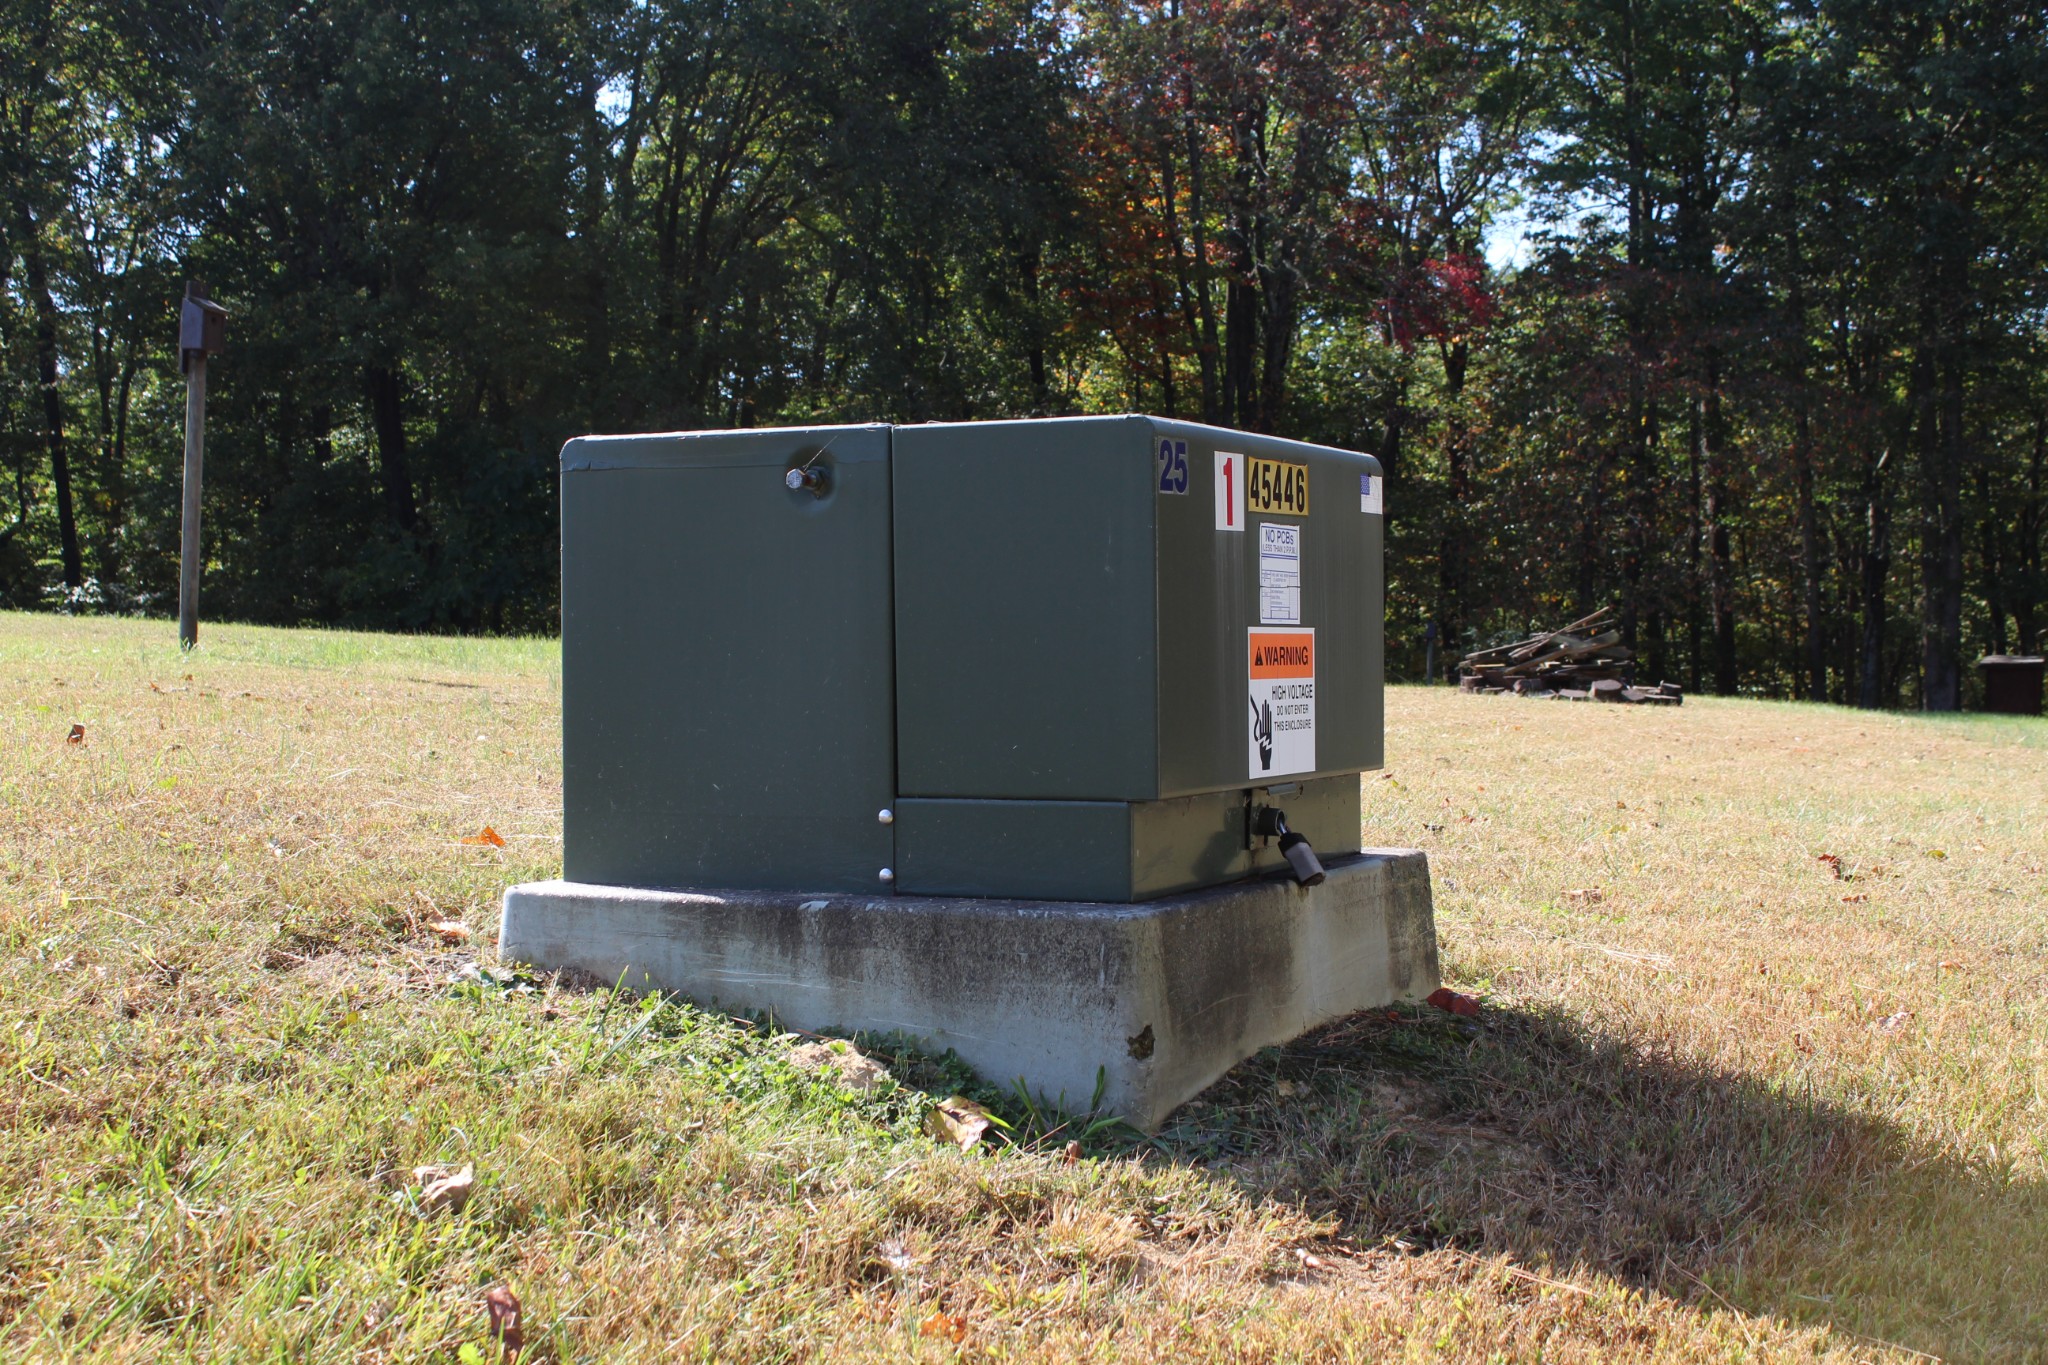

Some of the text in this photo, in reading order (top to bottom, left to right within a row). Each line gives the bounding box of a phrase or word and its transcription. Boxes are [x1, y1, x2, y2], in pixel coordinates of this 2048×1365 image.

[1159, 439, 1188, 494] 25
[1223, 457, 1233, 526] 1
[1250, 461, 1305, 513] 45446
[1265, 529, 1294, 545] NO PCBs
[1264, 646, 1308, 666] WARNING
[1272, 684, 1313, 700] HIGH VOLTAGE
[1277, 704, 1308, 716] DO NOT ENTER
[1274, 719, 1311, 731] THIS ENCLOSURE
